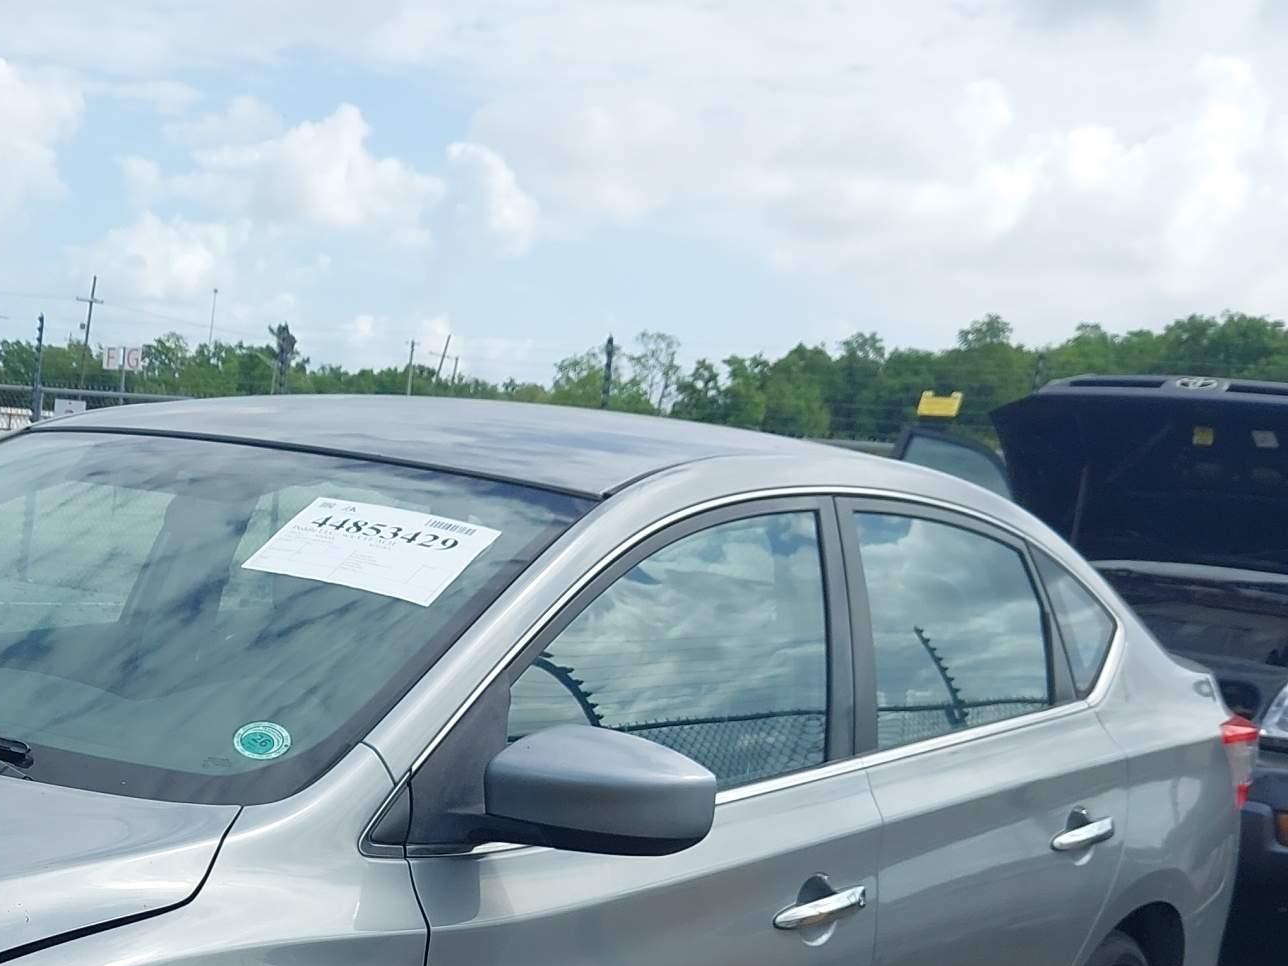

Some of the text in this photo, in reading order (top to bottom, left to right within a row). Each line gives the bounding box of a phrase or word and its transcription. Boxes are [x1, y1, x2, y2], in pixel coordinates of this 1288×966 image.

[106, 347, 139, 368] F G
[312, 515, 459, 551] 44853429
